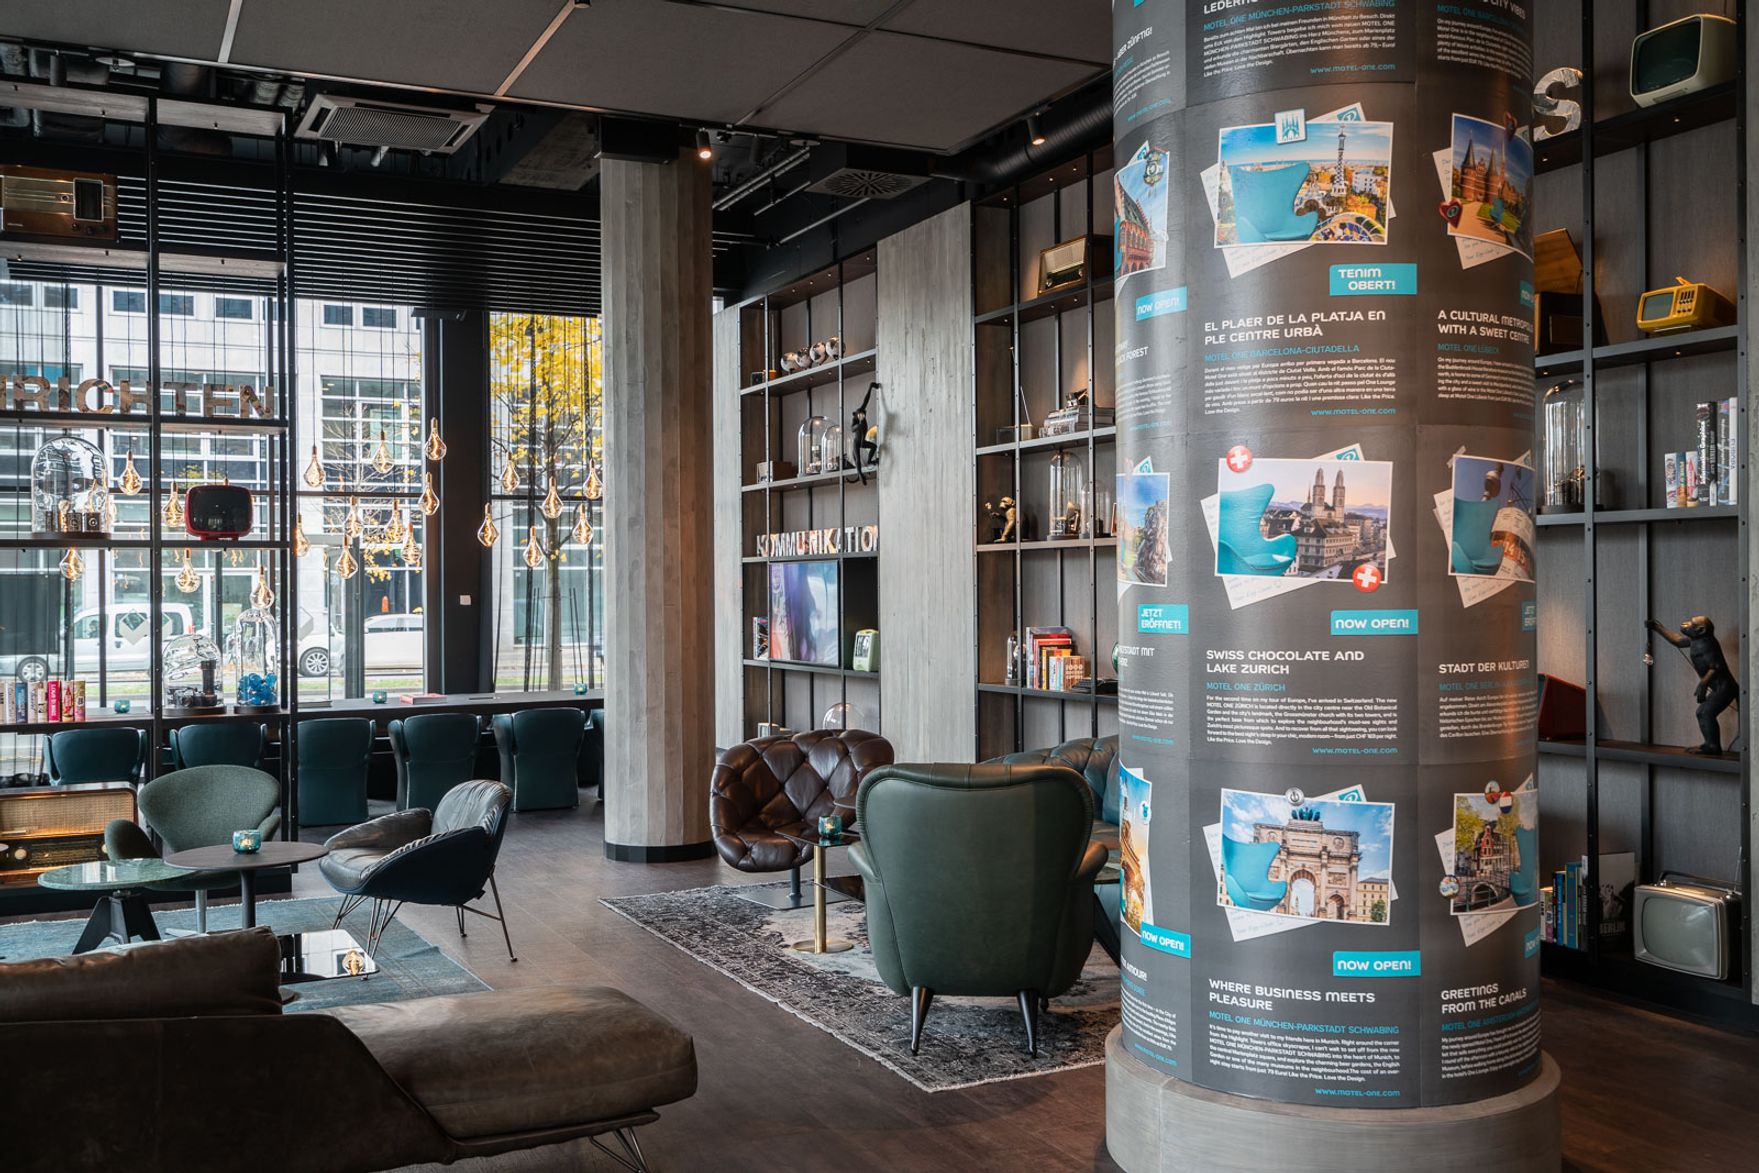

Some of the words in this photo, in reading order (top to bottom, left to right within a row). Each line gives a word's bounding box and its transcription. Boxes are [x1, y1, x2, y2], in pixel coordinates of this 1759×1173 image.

[1203, 19, 1228, 31] MOTEL
[1230, 14, 1247, 25] ONE
[1338, 268, 1381, 279] TENIM
[1348, 280, 1396, 290] OBERT!
[1204, 322, 1218, 332] EL
[1221, 317, 1263, 330] PLAER
[1266, 314, 1284, 325] DE
[1288, 313, 1307, 324] LA
[1311, 311, 1364, 323] PLATJA
[1368, 310, 1386, 321] EN
[1437, 310, 1447, 320] A
[1450, 310, 1500, 324] CULTURAL
[1204, 334, 1226, 345] PLE
[1229, 328, 1280, 342] CENTRE
[1284, 324, 1323, 338] URBÀ
[1437, 323, 1467, 335] WITH
[1469, 325, 1477, 336] A
[1479, 326, 1508, 339] SWEET
[1204, 352, 1229, 362] MOTEL
[1250, 345, 1360, 358] BARCELONA-CIUTADELLA
[1437, 343, 1462, 352] MOTEL
[0, 375, 274, 419] RICHTEN
[1141, 608, 1164, 618] JETZT
[1141, 618, 1182, 629] ERÖFFNET!
[1335, 619, 1367, 629] NOW
[1371, 619, 1409, 629] OPEN!
[1206, 650, 1245, 660] SWISS
[1248, 650, 1330, 661] CHOCOLATE
[1334, 651, 1365, 661] AND
[1206, 663, 1237, 673] LAKE
[1240, 664, 1289, 674] ZURICH
[1438, 663, 1475, 674] STADT
[1478, 662, 1496, 672] DER
[1206, 681, 1232, 690] MOTEL
[1234, 682, 1252, 691] ONE
[1254, 682, 1286, 691] ZÜRICH
[1141, 930, 1158, 943] NOW
[1159, 936, 1184, 951] OPEN!
[1337, 960, 1369, 970] NOW
[1373, 960, 1411, 970] OPEN!
[1209, 978, 1252, 994] WHERE
[1255, 985, 1321, 1001] BUSINESS
[1325, 991, 1375, 1003] MEETS
[1440, 983, 1499, 1001] GREETINGS
[1209, 991, 1273, 1011] PLEASURE
[1441, 1001, 1476, 1014] FROM
[1478, 997, 1497, 1009] THE
[1498, 988, 1527, 1005] CANALS
[1209, 1010, 1234, 1022] MOTEL
[1235, 1015, 1252, 1025] ONE
[1253, 1017, 1345, 1033] MÜNCHEN-PARKSTADT
[1348, 1025, 1399, 1034] SCHWABING
